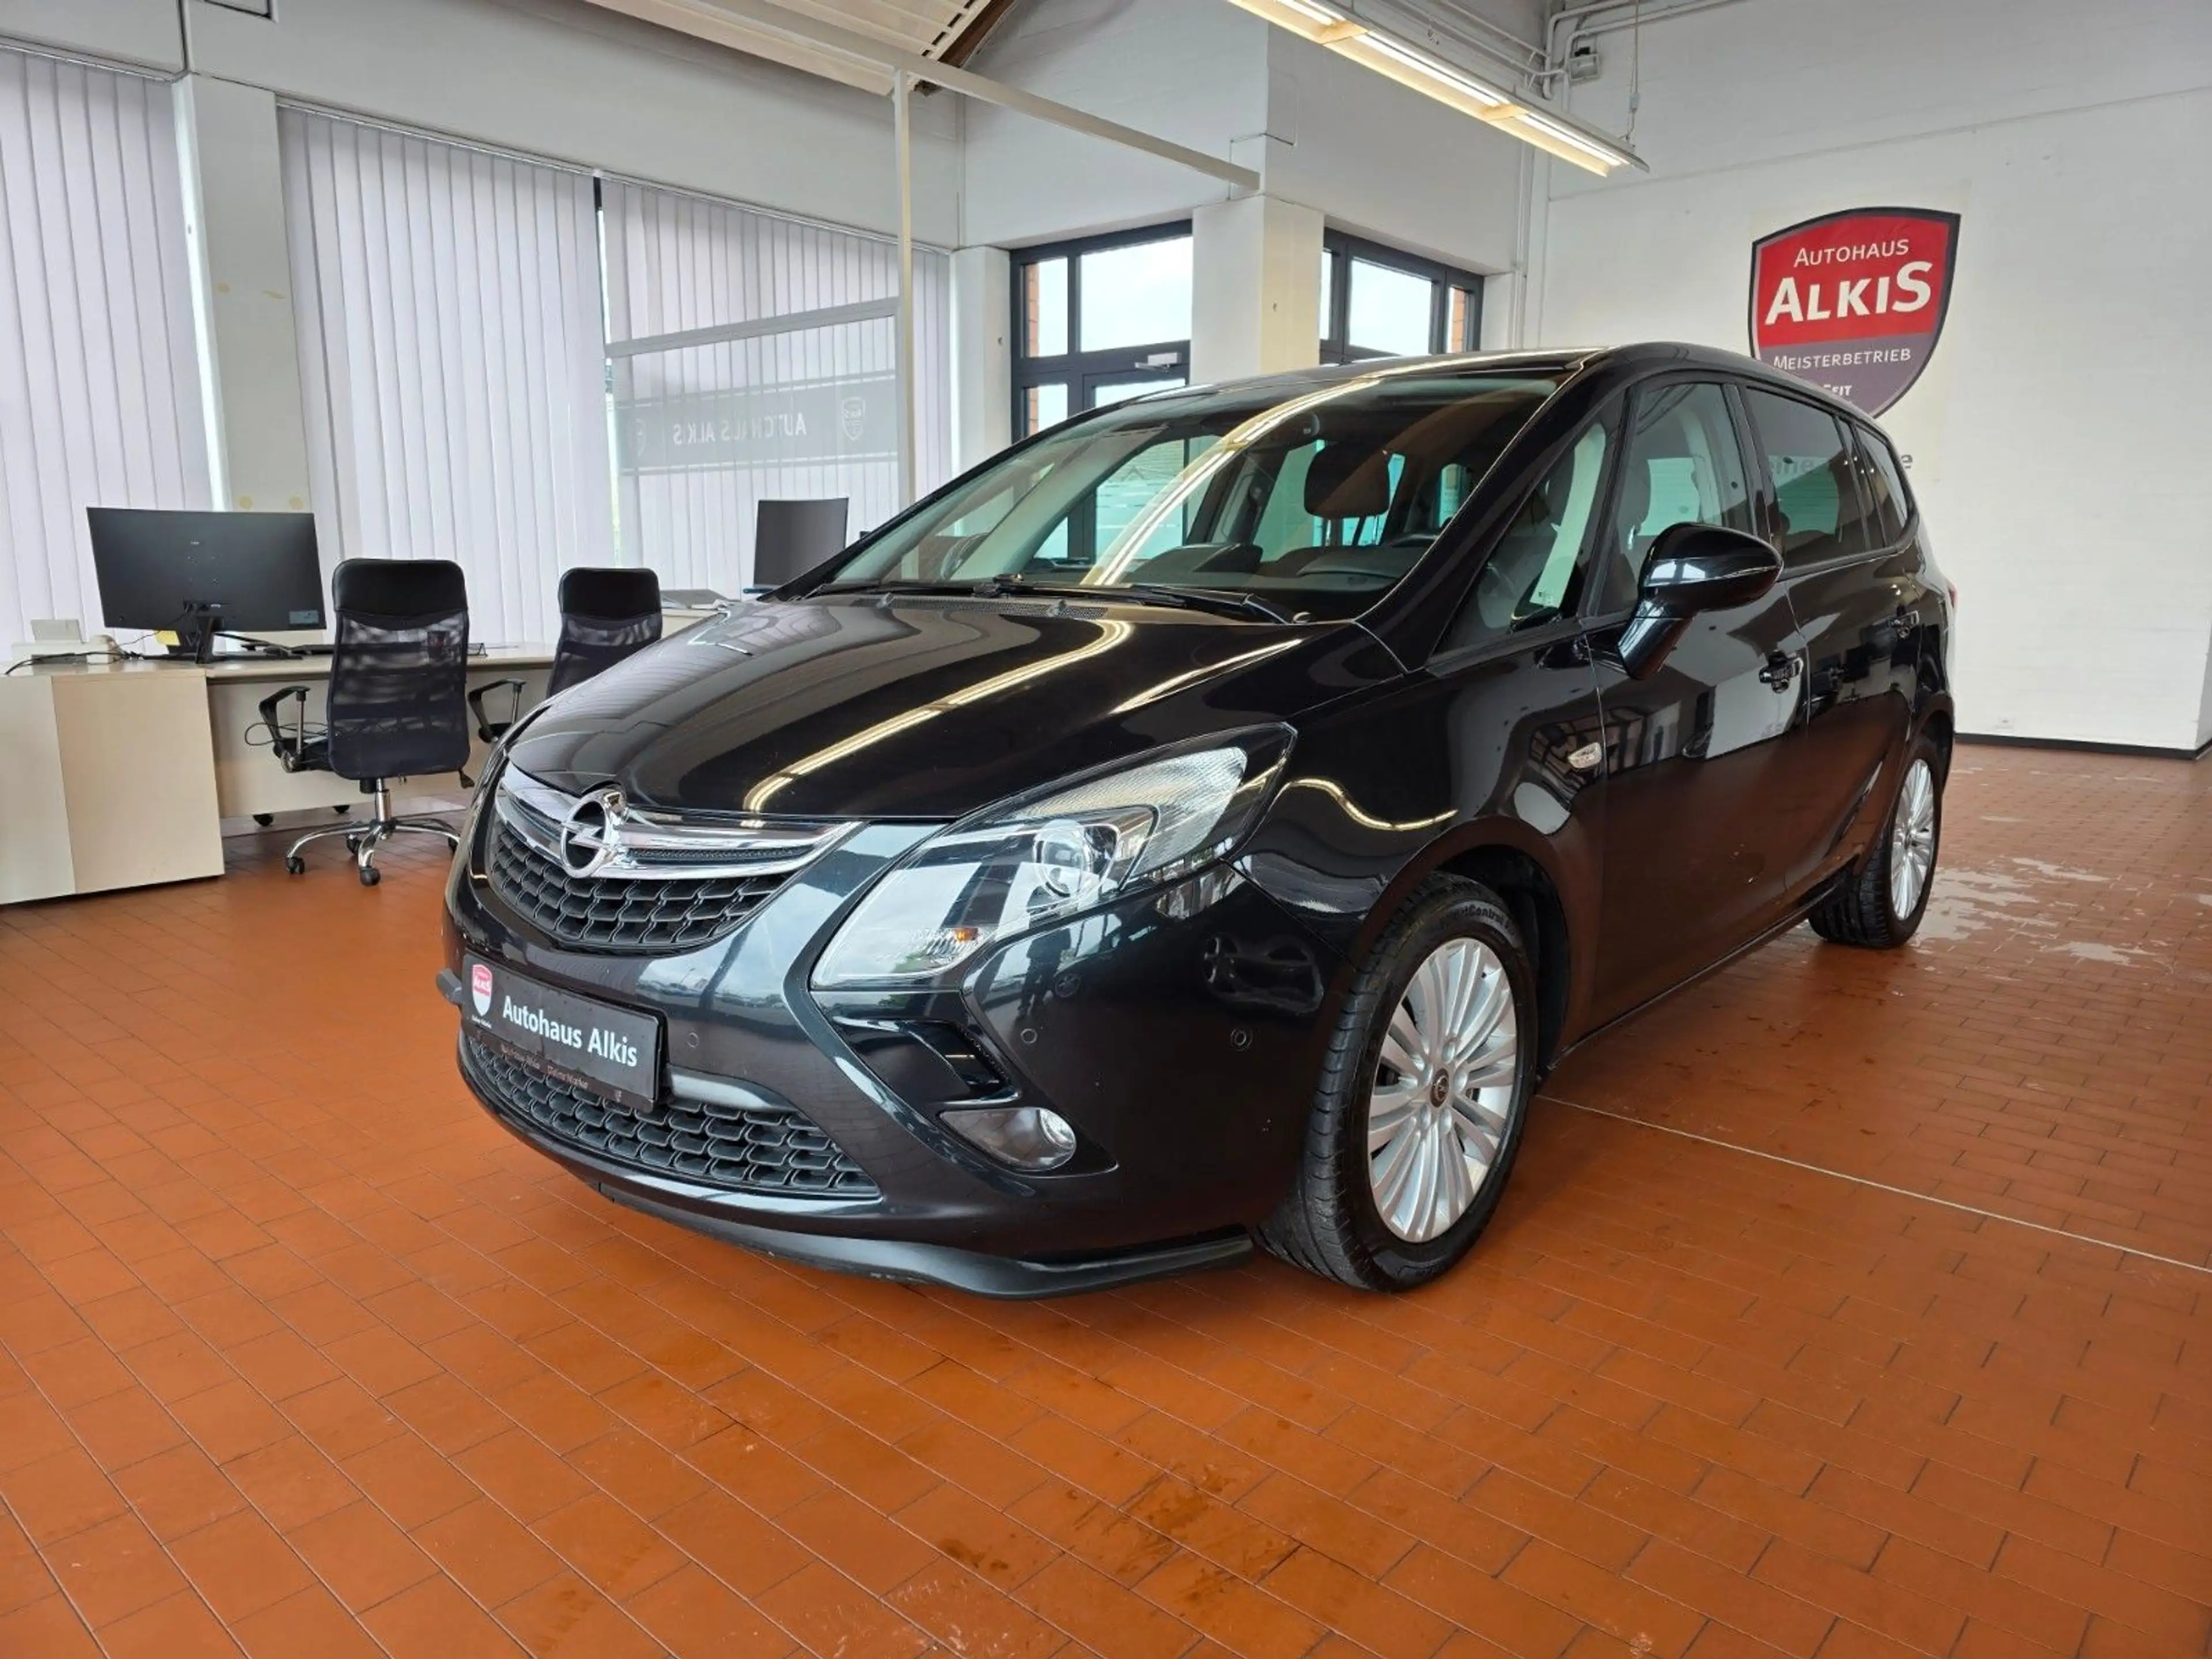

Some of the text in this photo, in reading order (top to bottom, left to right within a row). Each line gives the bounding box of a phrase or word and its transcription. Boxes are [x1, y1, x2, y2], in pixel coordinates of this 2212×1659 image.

[1793, 238, 1910, 268] AUTOHAUS
[1764, 261, 1933, 326] ALKIS
[1774, 348, 1911, 370] MEISTERBETRIEB
[1823, 384, 1853, 396] EIT
[503, 995, 583, 1048] Autohaus
[587, 1027, 637, 1066] Alkis
